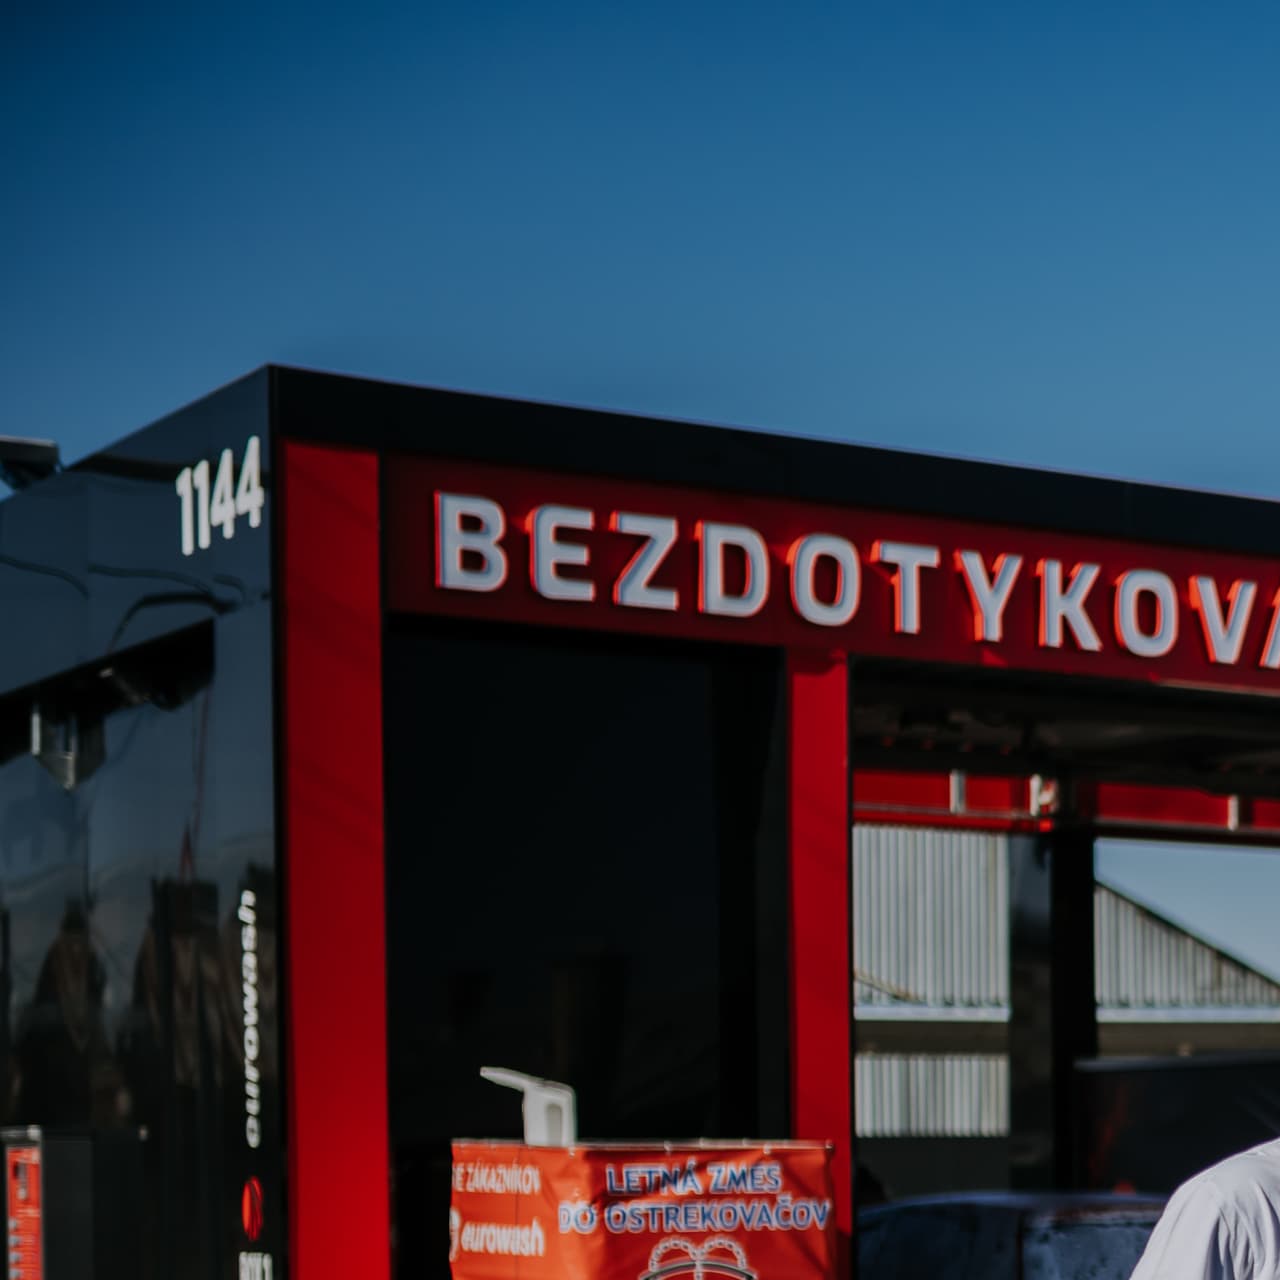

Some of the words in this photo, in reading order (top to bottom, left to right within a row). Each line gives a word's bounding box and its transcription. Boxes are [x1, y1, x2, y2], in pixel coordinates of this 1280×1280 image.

[176, 435, 265, 556] 1144
[606, 1161, 701, 1194] LETNÁ
[708, 1163, 782, 1194] ZMES
[558, 1203, 596, 1233] DO
[604, 1196, 831, 1233] OSTREKOVAČOV
[461, 1217, 545, 1257] eurowash
